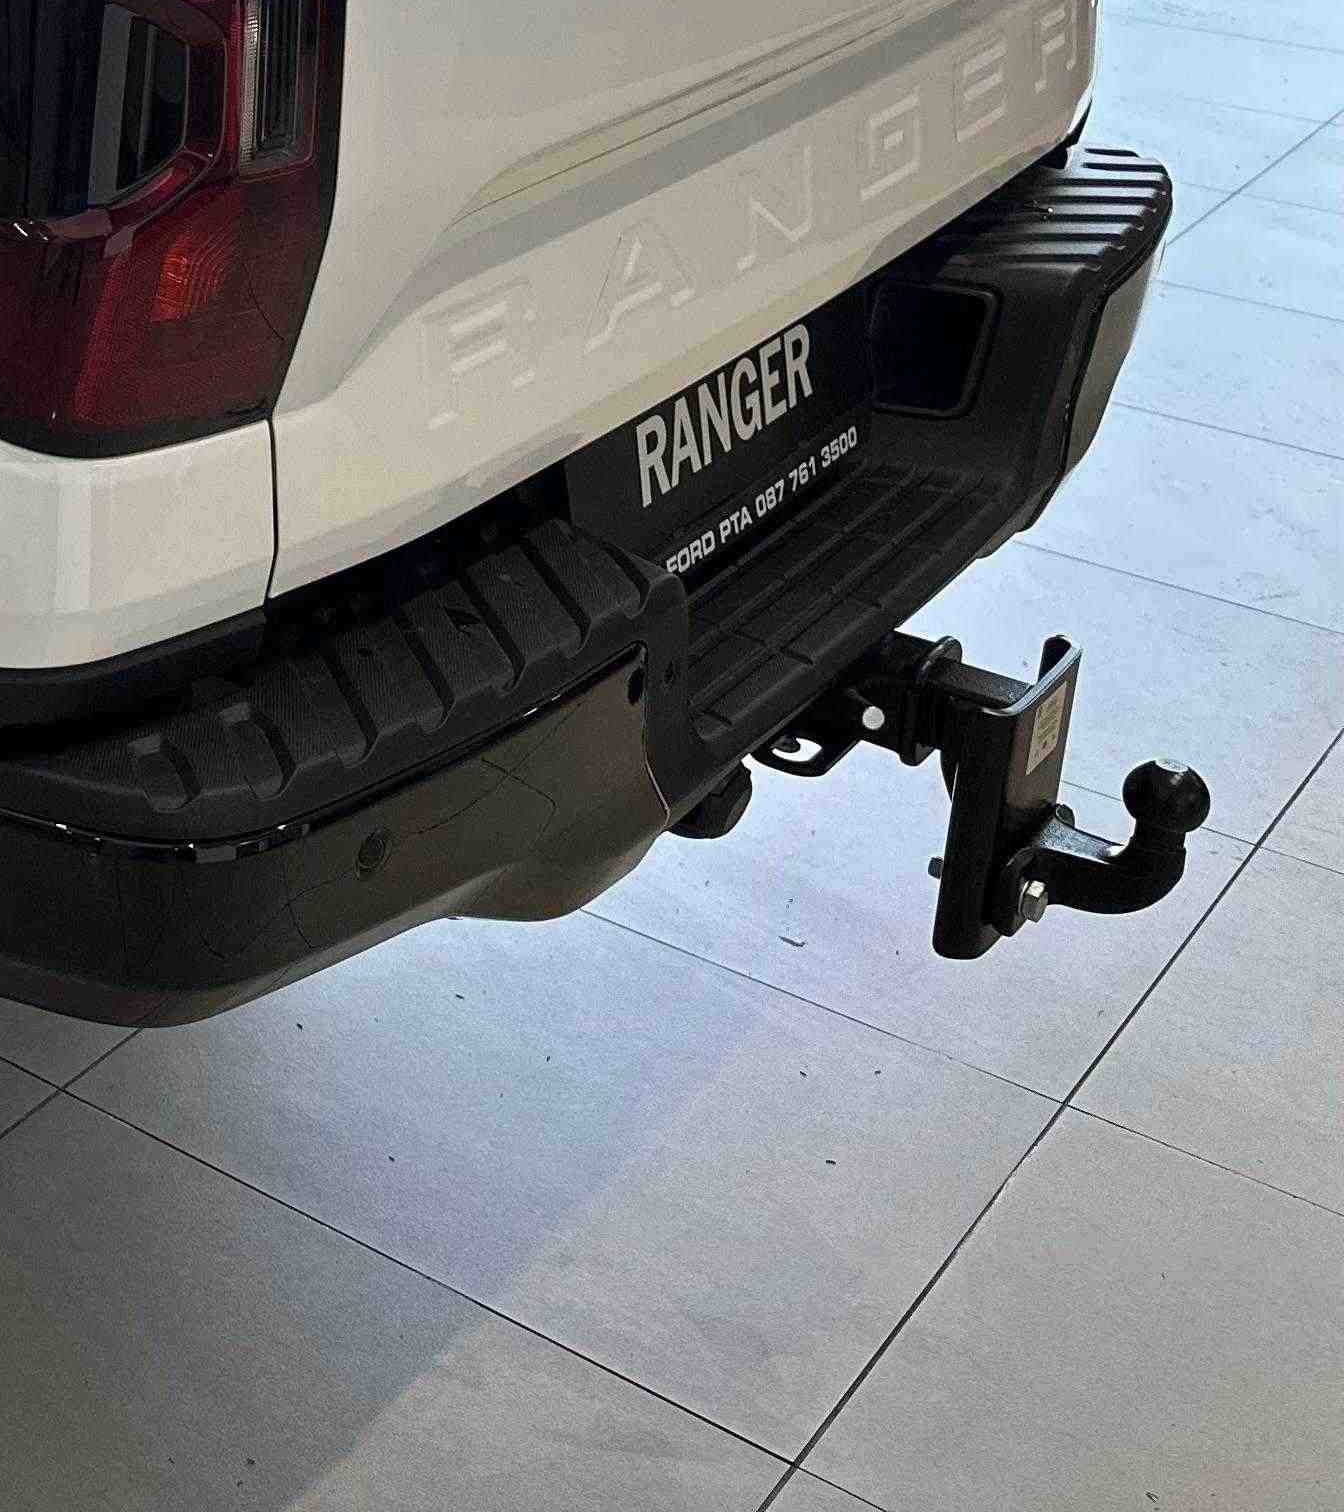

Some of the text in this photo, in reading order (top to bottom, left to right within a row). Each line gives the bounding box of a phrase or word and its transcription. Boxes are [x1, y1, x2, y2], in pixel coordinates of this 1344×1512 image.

[635, 323, 814, 508] RANGER
[666, 425, 858, 574] FORD PTA 087 761 3500
